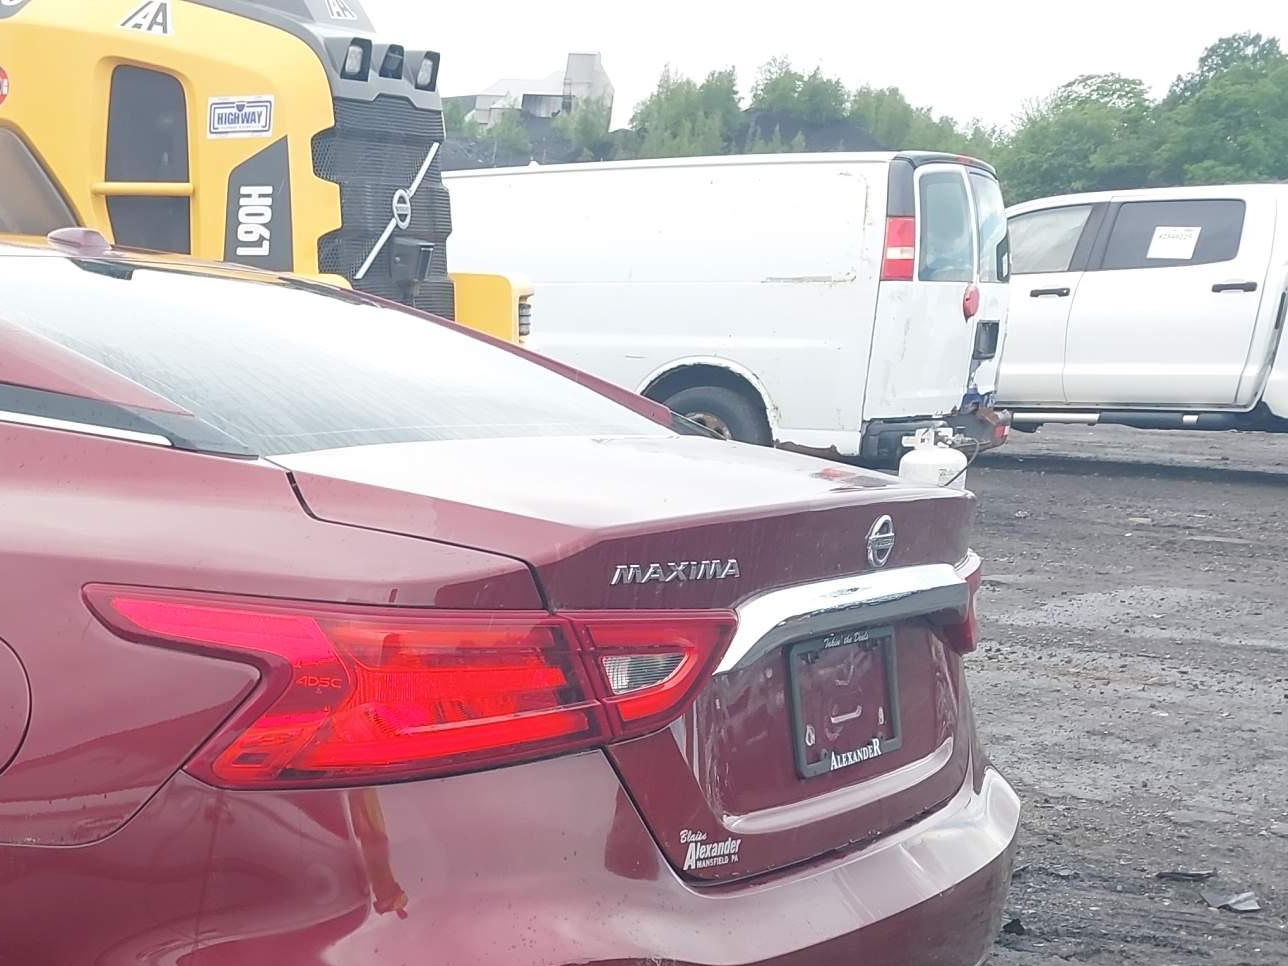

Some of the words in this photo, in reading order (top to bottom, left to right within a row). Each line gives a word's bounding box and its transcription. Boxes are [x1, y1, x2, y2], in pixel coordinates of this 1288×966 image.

[217, 111, 263, 125] HIGHWAY
[236, 186, 273, 256] L90H
[611, 559, 741, 585] MAXIMA
[830, 737, 882, 771] ALEXANDER
[682, 837, 742, 871] Alexander
[696, 855, 730, 869] MANSFIELD
[731, 854, 739, 864] PA
